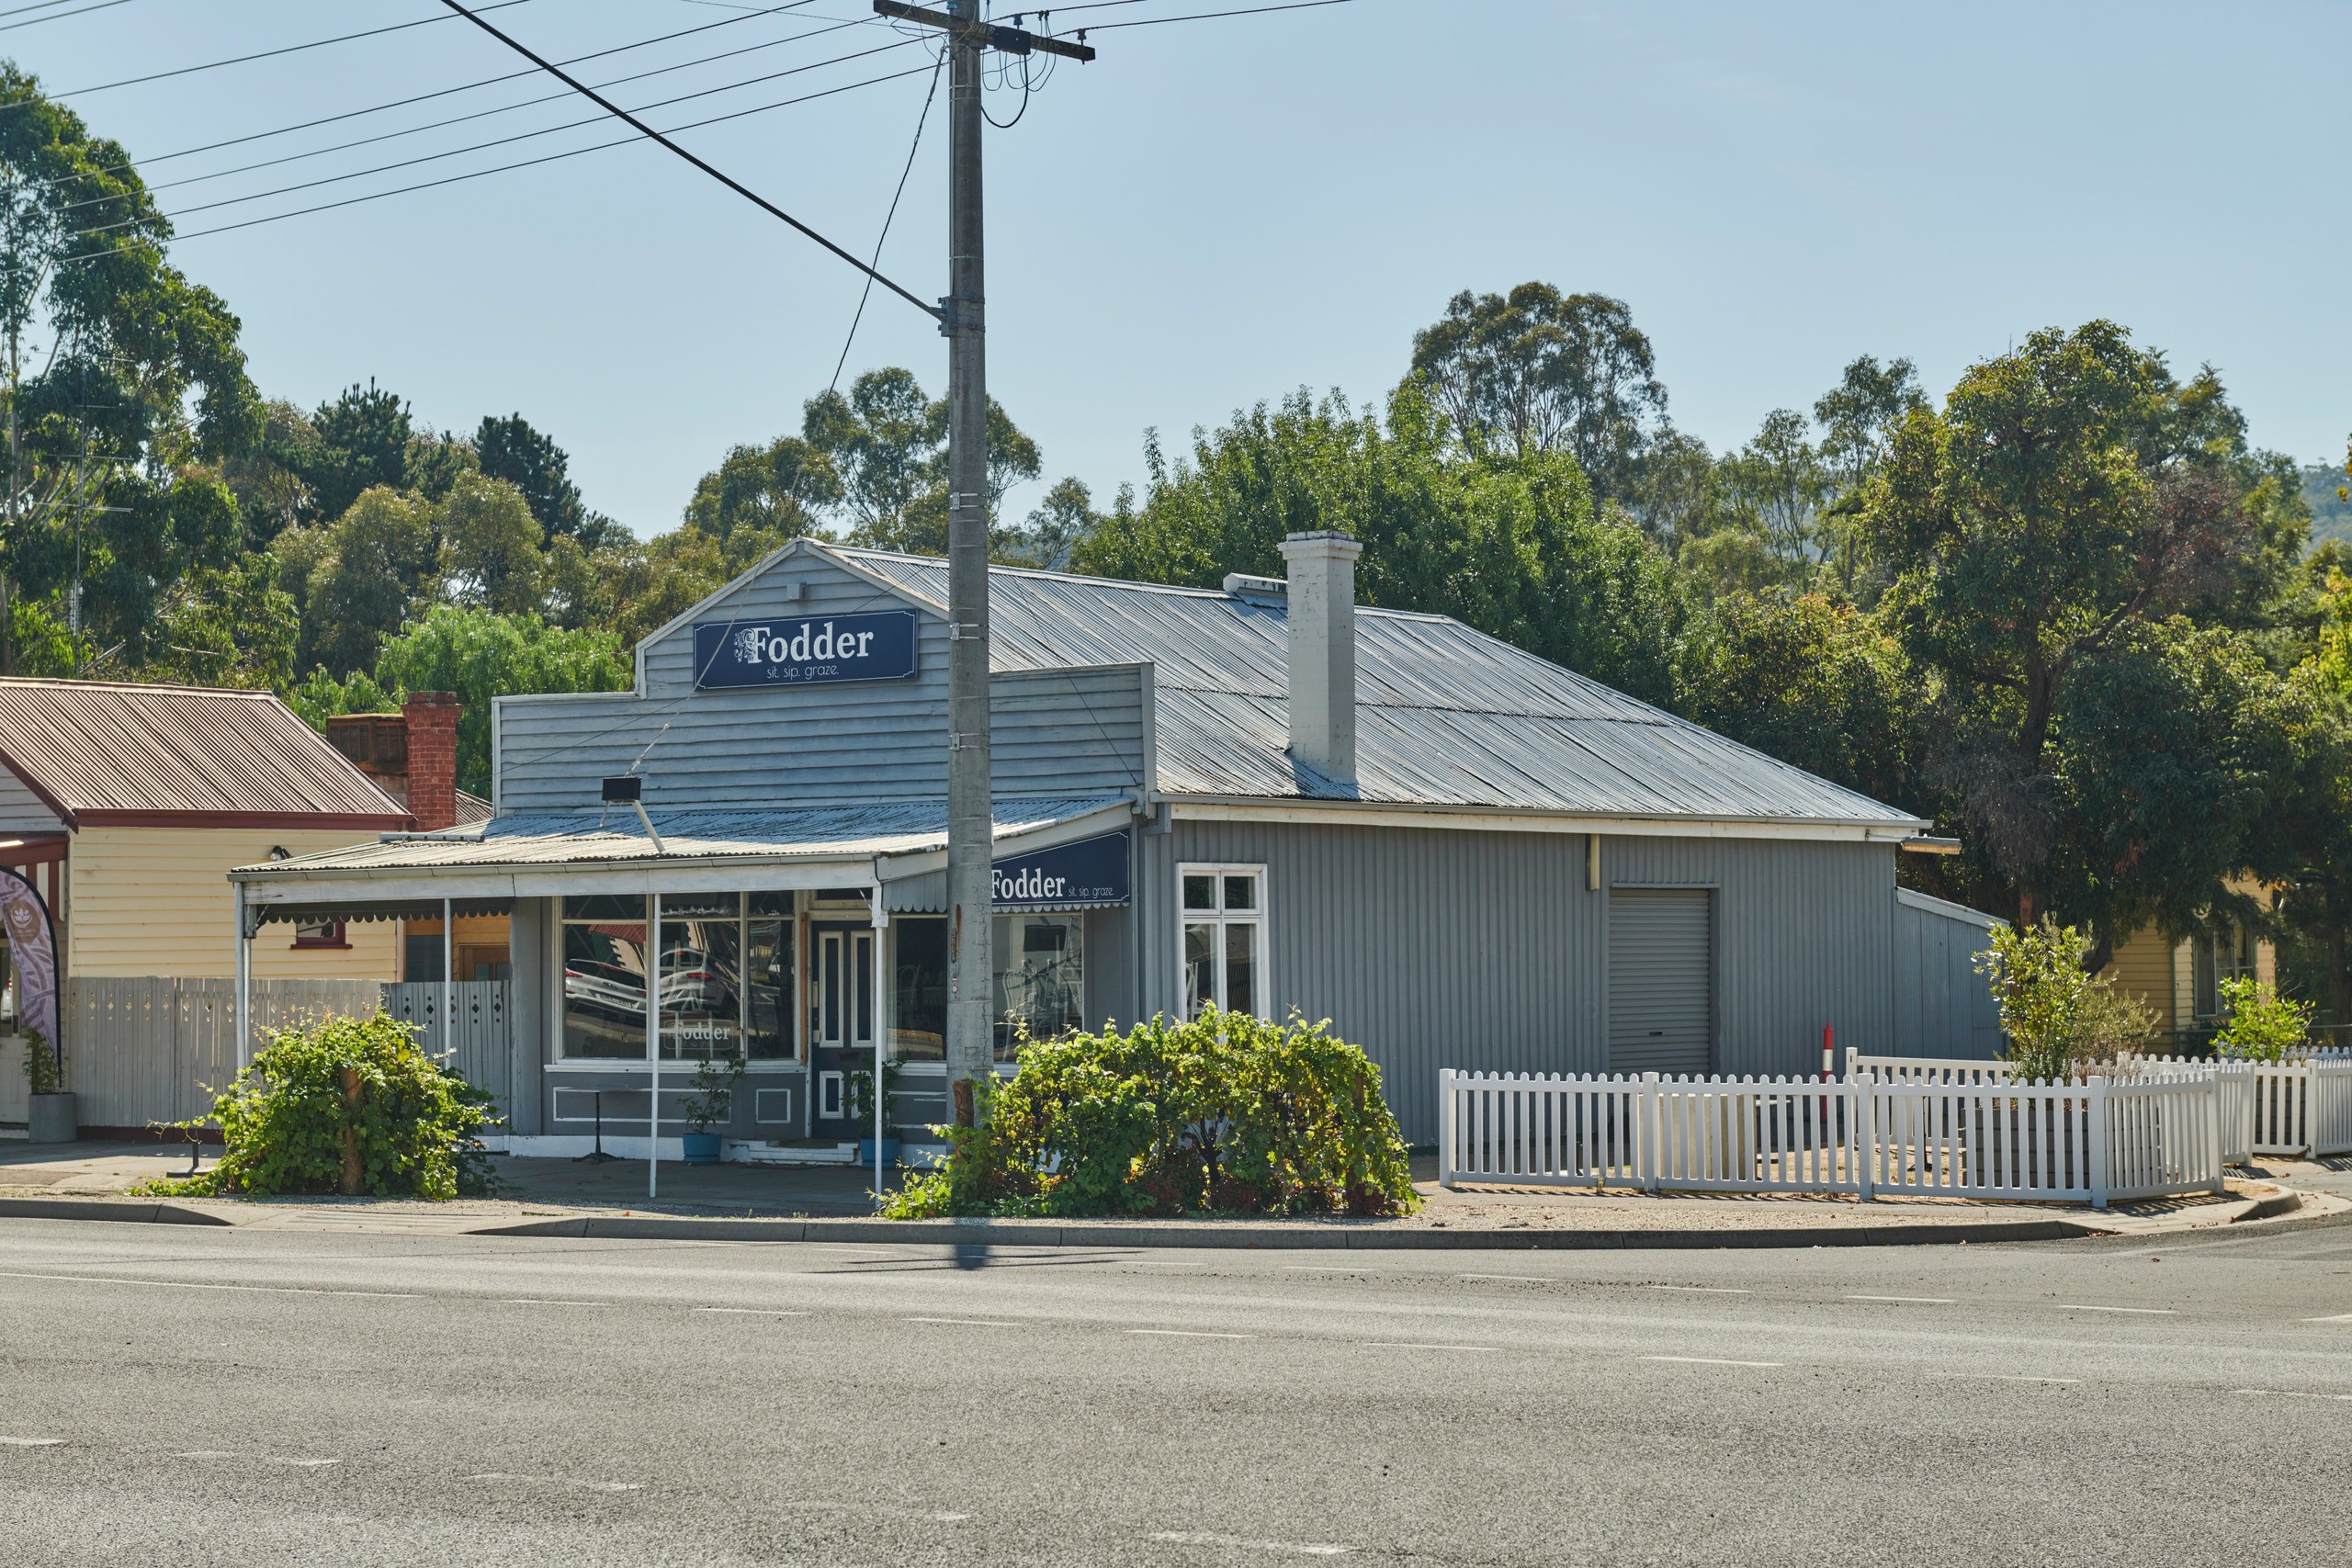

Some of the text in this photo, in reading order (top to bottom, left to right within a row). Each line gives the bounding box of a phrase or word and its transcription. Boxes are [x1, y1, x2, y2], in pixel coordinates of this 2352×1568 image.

[742, 621, 875, 664] Fodder
[766, 664, 840, 681] sit. sip. graze.
[991, 867, 1066, 899] Fodder
[1079, 886, 1091, 898] sip.
[1091, 886, 1114, 899] graze.
